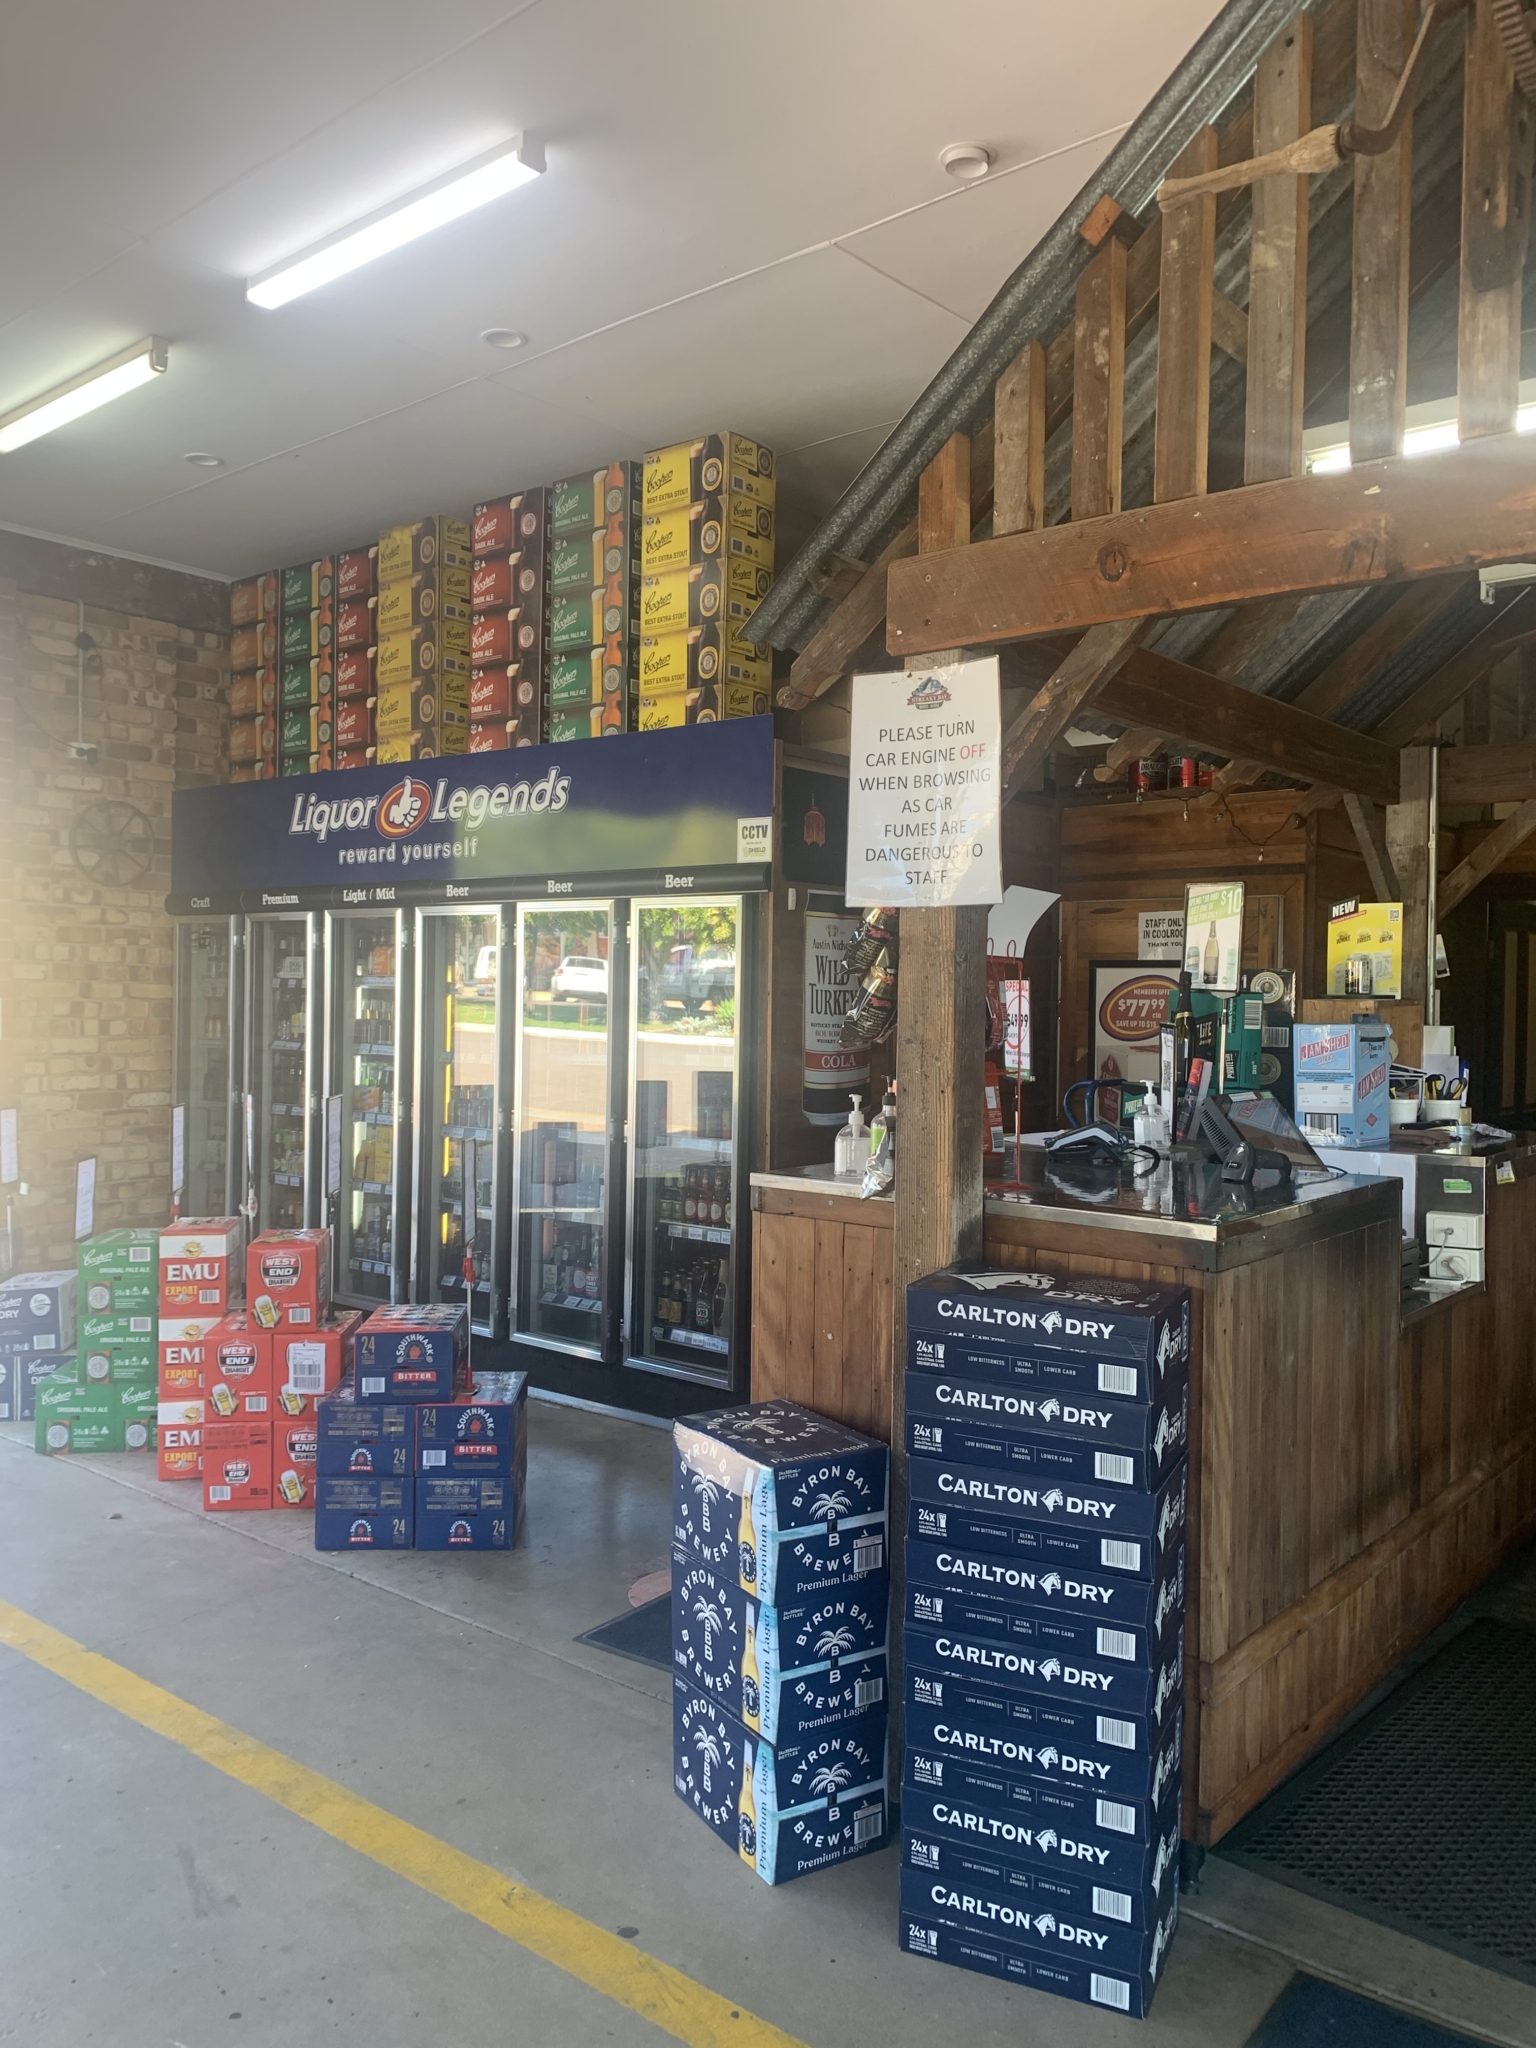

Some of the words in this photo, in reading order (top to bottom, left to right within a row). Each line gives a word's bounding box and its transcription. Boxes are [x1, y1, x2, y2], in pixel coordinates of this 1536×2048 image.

[646, 469, 674, 493] Coopers
[647, 496, 658, 504] BEST
[659, 491, 673, 502] EXTRA
[674, 487, 688, 498] STOUT
[475, 541, 486, 550] DARK
[571, 632, 580, 640] PALE
[472, 651, 483, 659] DARK
[644, 652, 670, 675] Coopers
[644, 678, 655, 686] BEST
[656, 676, 670, 684] EXTRA
[671, 674, 685, 682] STOUT
[880, 726, 933, 742] PLEASE
[938, 721, 975, 738] TURN
[866, 753, 895, 767] CAR
[902, 747, 956, 765] ENGINE
[960, 744, 986, 760] OFF
[859, 777, 908, 791] WHEN
[914, 768, 991, 788] BROWSING
[290, 794, 378, 841] Liquor
[430, 767, 571, 830] Legends
[902, 799, 920, 813] AS
[926, 797, 952, 811] CAR
[742, 825, 768, 839] CCTV
[884, 823, 936, 837] FUMES
[941, 820, 966, 835] ARE
[339, 843, 396, 865] reward
[402, 836, 478, 865] yourself
[866, 844, 959, 861] DANGEROUS
[966, 844, 982, 857] TO
[665, 873, 693, 889] Beer
[905, 870, 947, 885] STAFF
[446, 885, 469, 897] Beer
[547, 879, 572, 894] Beer
[191, 897, 210, 908] Craft
[262, 893, 299, 904] Premium
[343, 890, 366, 903] Light
[376, 888, 395, 900] Mid
[1221, 888, 1241, 914] $10
[1332, 900, 1355, 917] NEW
[1145, 919, 1166, 928] STAFF
[1168, 918, 1185, 927] ONL
[1144, 930, 1150, 939] IN
[813, 939, 830, 950] Austin
[816, 955, 850, 986] WILD
[1006, 981, 1028, 992] SPECAL
[1302, 1044, 1322, 1060] JAM
[1322, 1035, 1347, 1054] SHED
[821, 1054, 856, 1068] COLA
[83, 1248, 113, 1266] Coopers
[266, 1258, 296, 1266] WEST
[166, 1263, 220, 1282] EMU
[269, 1268, 293, 1276] END
[268, 1278, 293, 1286] DRAUGHT
[165, 1286, 198, 1296] EXPORT
[937, 1299, 1037, 1330] CARLTON
[1065, 1319, 1116, 1340] DRY
[84, 1319, 114, 1337] Coopers
[361, 1336, 375, 1353] 24
[396, 1334, 434, 1356] SOUTHWARK
[916, 1340, 934, 1354] 24x
[226, 1357, 249, 1365] END
[978, 1356, 1005, 1366] BITTERNESS
[1017, 1360, 1032, 1368] ULTRA
[165, 1369, 198, 1379] EXPORT
[398, 1372, 431, 1380] BITTER
[1015, 1366, 1034, 1375] SMOOTH
[1044, 1366, 1061, 1374] LOWER
[1062, 1368, 1076, 1376] CARB
[423, 1409, 436, 1426] 24
[457, 1407, 495, 1430] SOUTHWARK
[164, 1452, 197, 1462] EXPORT
[394, 1449, 406, 1464] 24
[680, 1441, 719, 1475] BYRON
[719, 1458, 734, 1503] BAY
[791, 1465, 840, 1508] BYRON
[846, 1468, 871, 1497] BAY
[937, 1473, 1038, 1507] CARLTON
[1066, 1496, 1116, 1519] DRY
[493, 1520, 505, 1535] 24
[681, 1503, 733, 1563] BREWERY
[797, 1577, 839, 1592] Premium
[843, 1571, 868, 1582] Lager
[935, 1638, 1035, 1676] CARLTON
[1064, 1667, 1114, 1691] DRY
[914, 1677, 931, 1692] 24x
[791, 1738, 841, 1785] BYRON
[846, 1740, 870, 1766] BAY
[797, 1851, 840, 1871] Premium
[843, 1841, 868, 1855] Lager
[930, 1885, 1030, 1930] CARLTON
[1059, 1923, 1109, 1950] DRY
